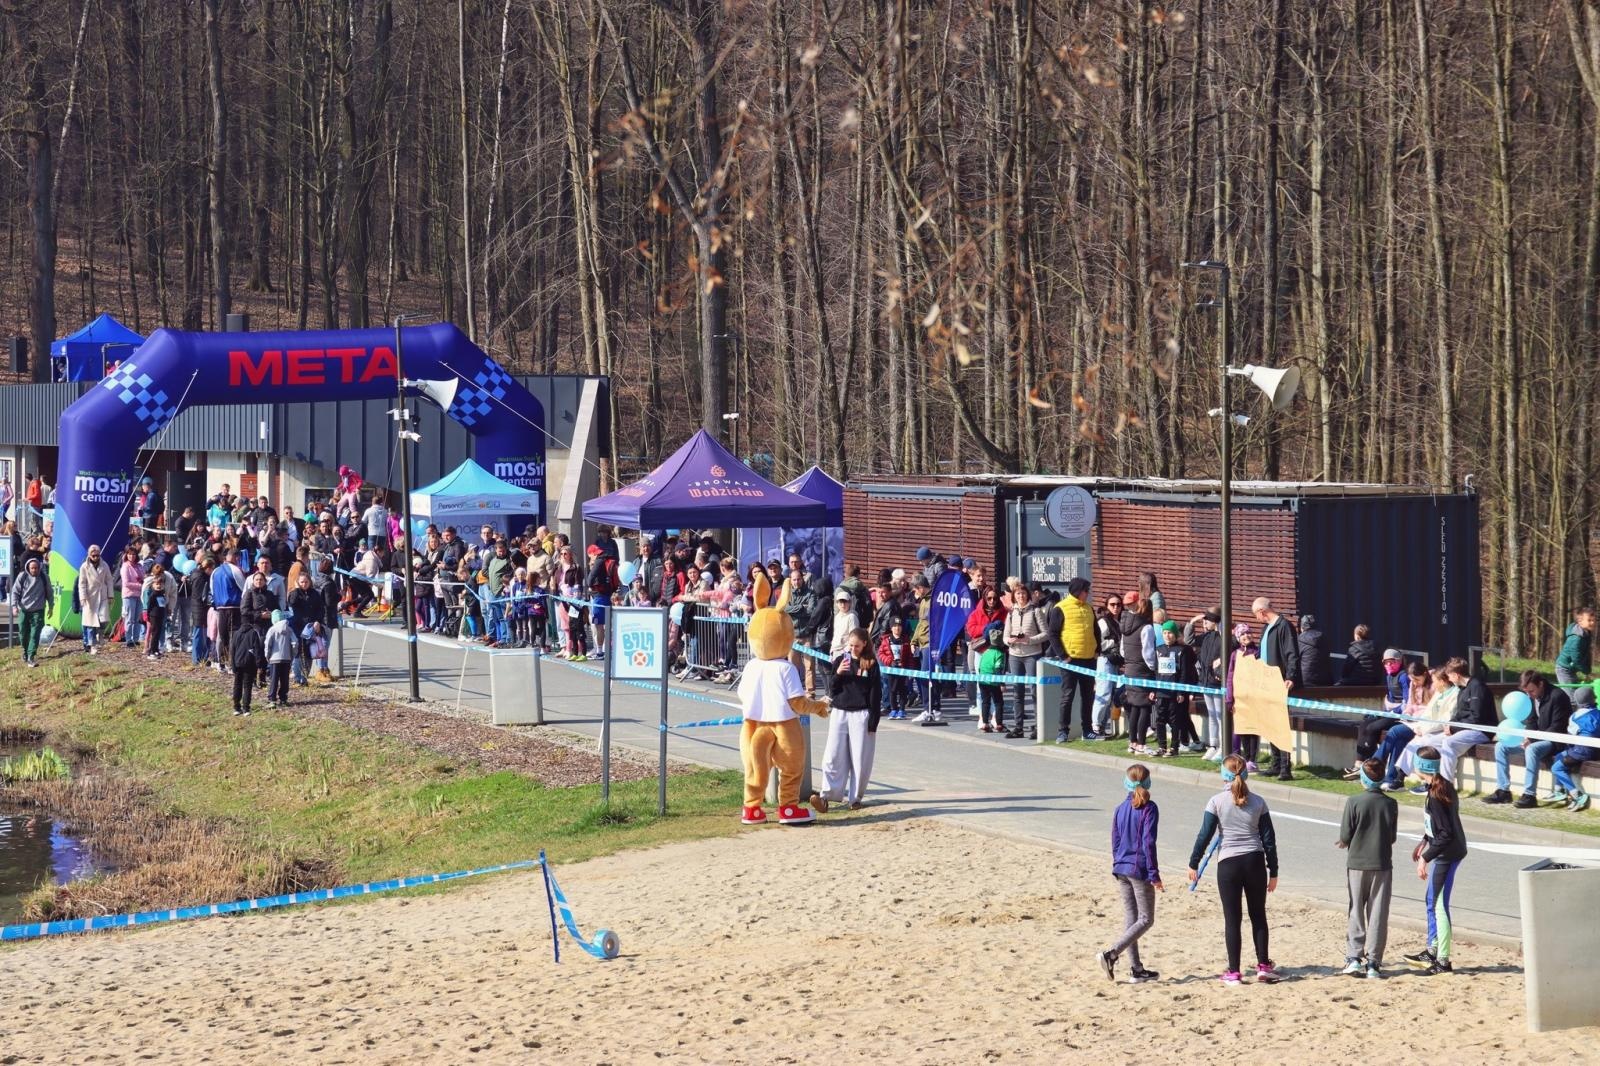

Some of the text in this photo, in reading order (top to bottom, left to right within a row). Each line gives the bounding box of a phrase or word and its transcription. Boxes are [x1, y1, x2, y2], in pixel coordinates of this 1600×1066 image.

[228, 346, 403, 386] META
[494, 462, 545, 476] mosir
[74, 475, 131, 494] mosir
[504, 477, 542, 486] entrum
[695, 479, 750, 487] BROWAR
[81, 493, 125, 503] centrum
[1032, 556, 1045, 565] MAX
[936, 591, 971, 609] 400 m
